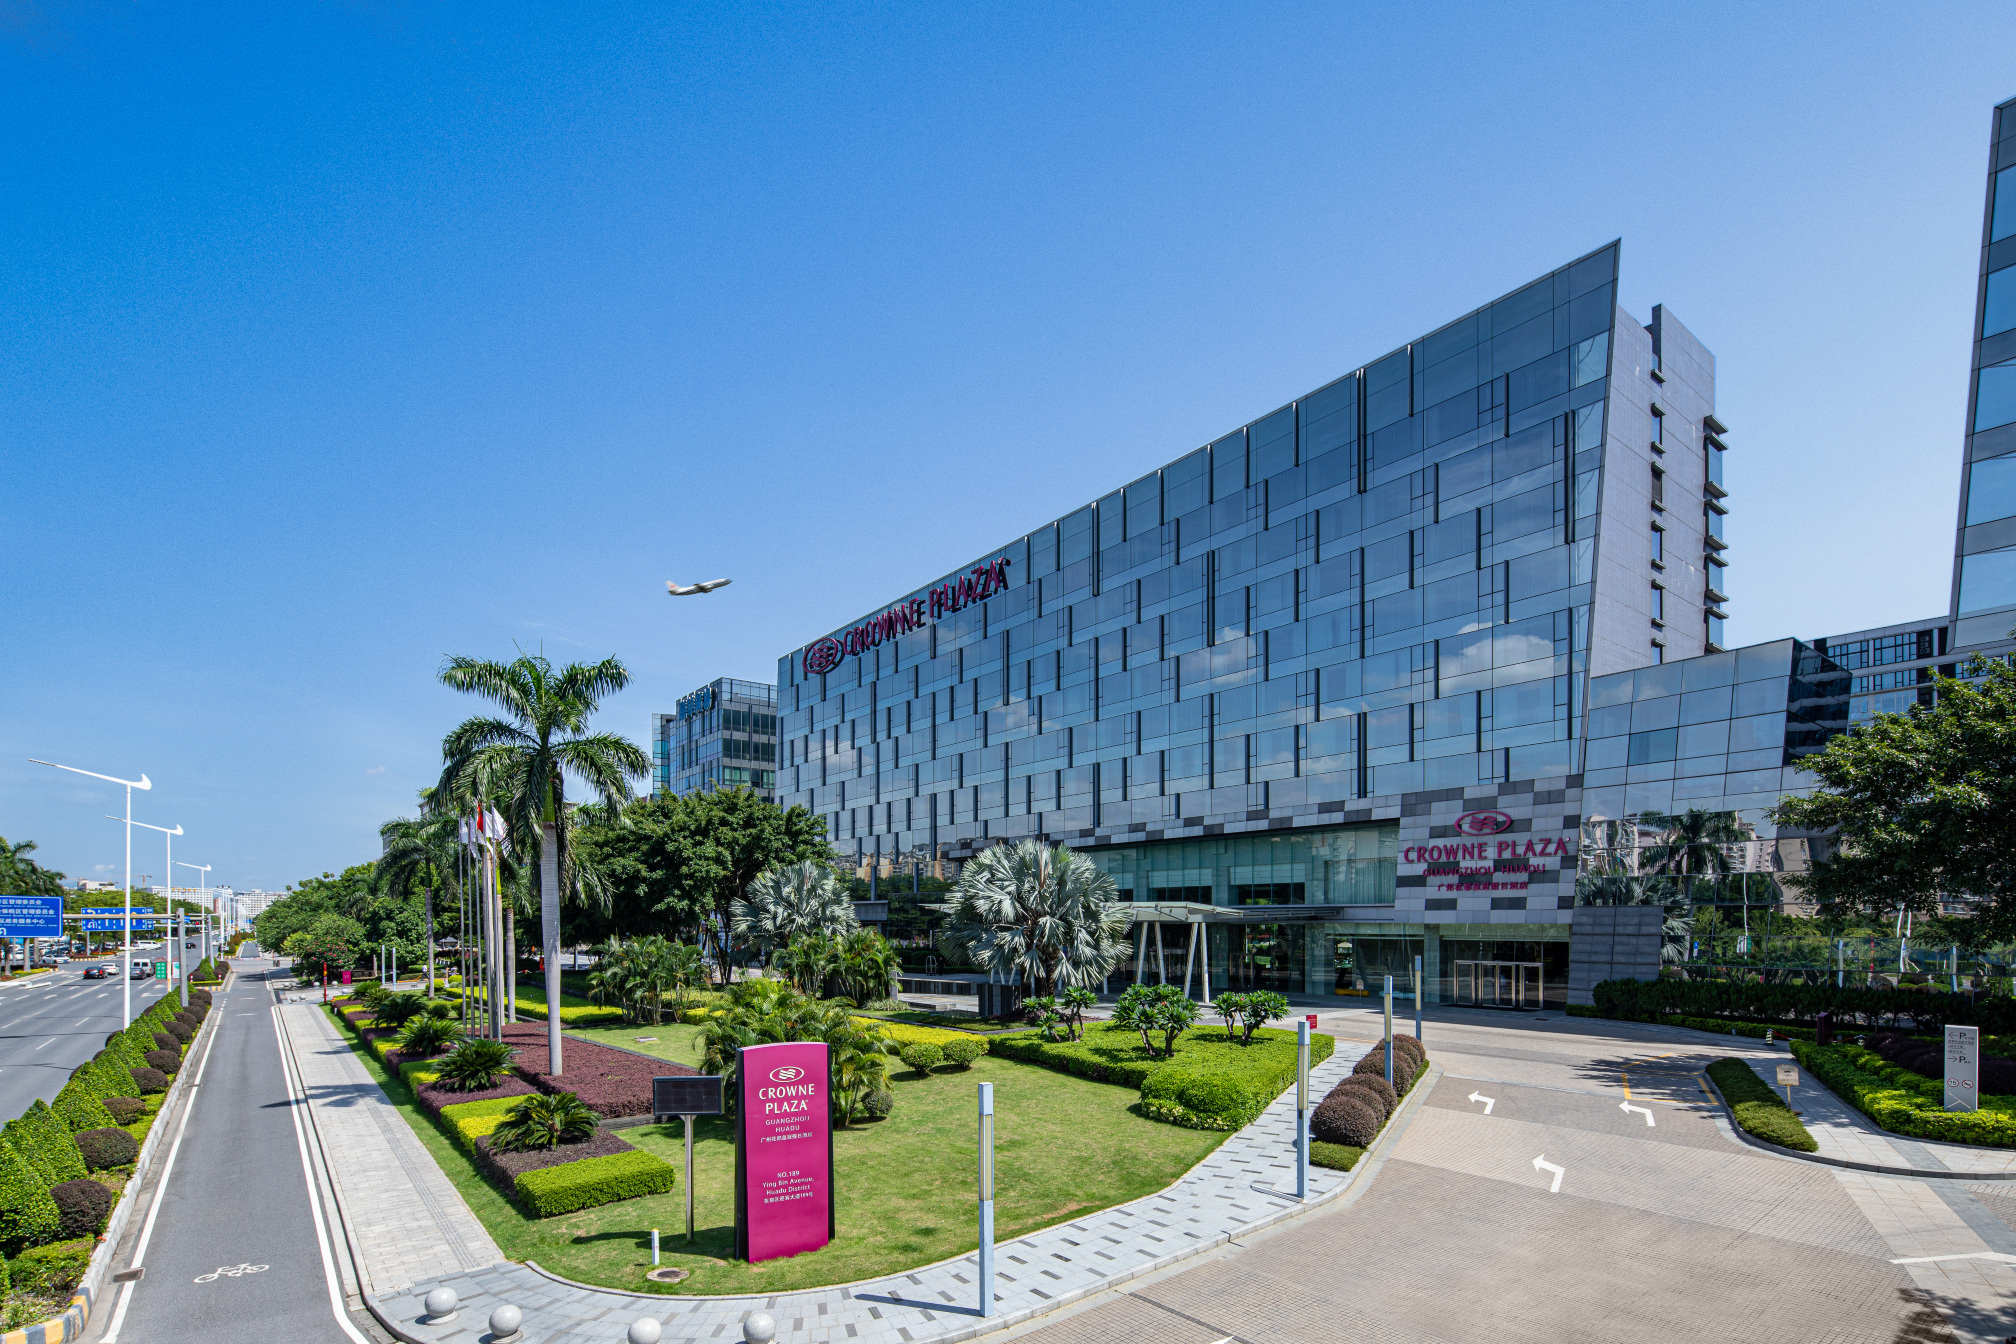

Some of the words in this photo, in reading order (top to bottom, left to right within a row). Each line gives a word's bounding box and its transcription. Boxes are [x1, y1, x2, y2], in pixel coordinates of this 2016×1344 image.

[843, 597, 919, 655] CROWNE
[929, 559, 1001, 618] PLAZA
[1403, 842, 1488, 863] CROWNE
[1496, 837, 1569, 858] PLAZA
[1422, 866, 1496, 878] GUANGZHOU
[1501, 864, 1546, 875] HUADU
[759, 1084, 815, 1100] CROWNE
[765, 1100, 808, 1114] PLAZA
[765, 1116, 810, 1126] GUANGZHOU
[775, 1125, 800, 1133] HUADU
[777, 1170, 800, 1178] NO.189
[766, 1187, 787, 1195] Huadu
[788, 1185, 811, 1193] District
